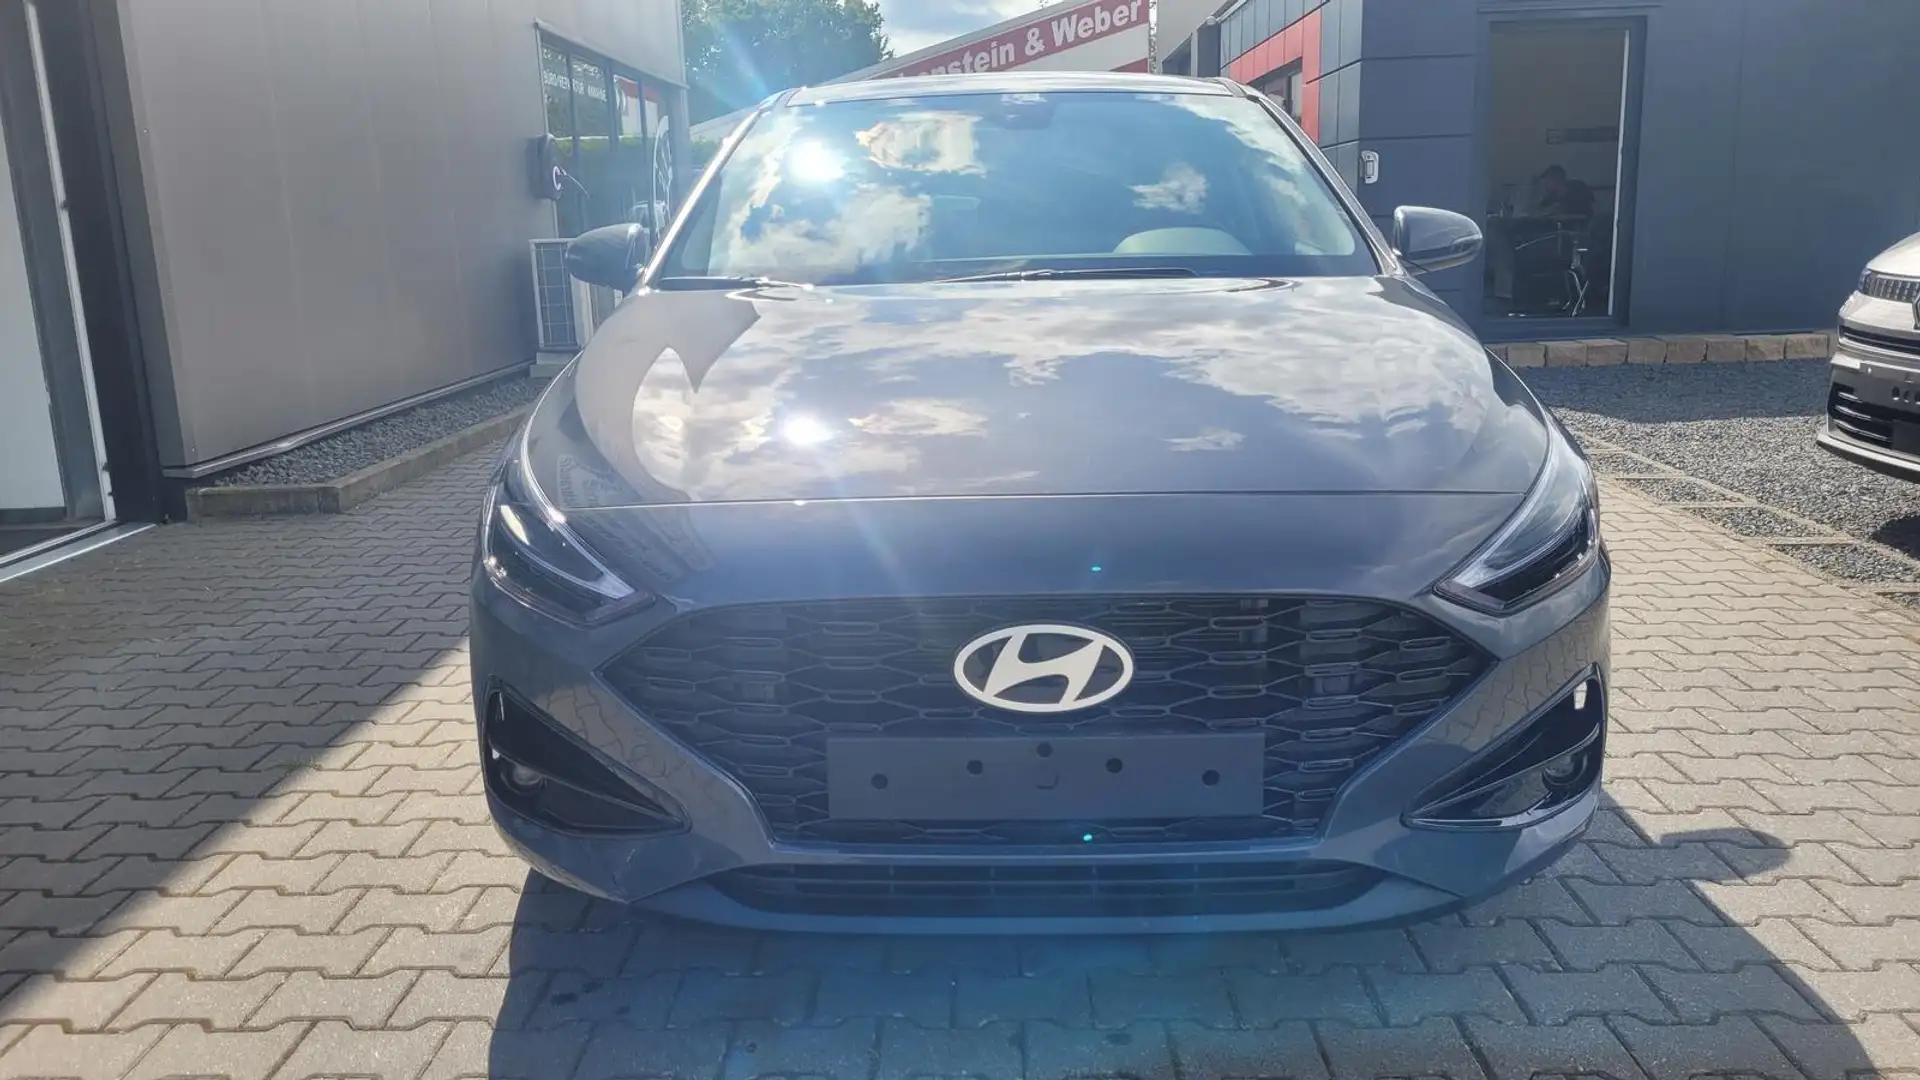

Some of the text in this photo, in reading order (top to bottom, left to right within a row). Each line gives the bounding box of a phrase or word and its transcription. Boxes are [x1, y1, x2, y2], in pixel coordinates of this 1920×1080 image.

[898, 0, 1141, 76] nstein & Weber
